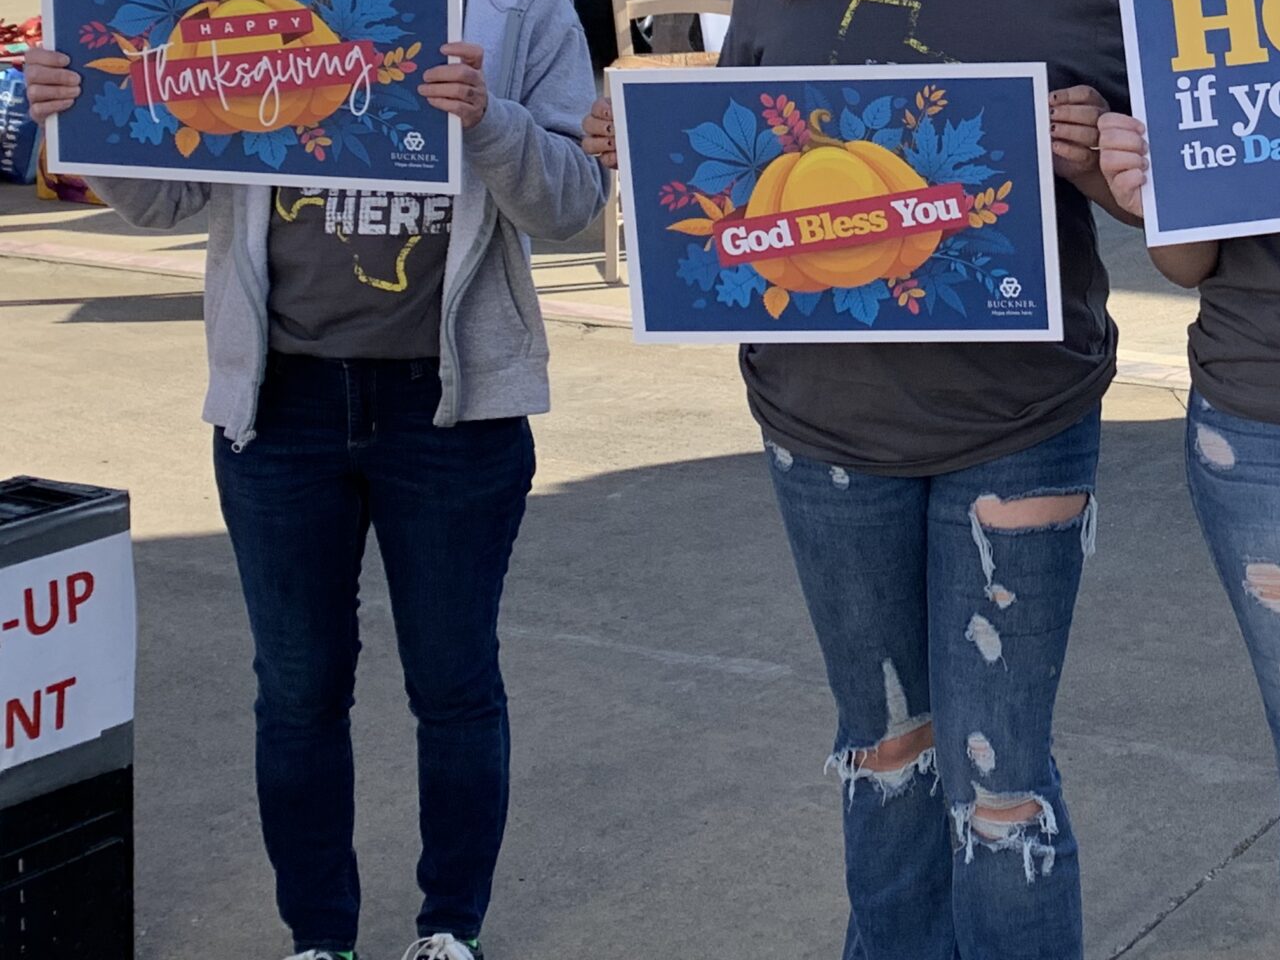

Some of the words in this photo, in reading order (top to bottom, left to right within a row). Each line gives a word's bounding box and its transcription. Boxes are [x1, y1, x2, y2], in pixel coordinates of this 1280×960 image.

[200, 17, 301, 35] HAPPY
[123, 40, 373, 127] Thanksgiving
[1175, 74, 1219, 130] if
[1180, 140, 1236, 171] the
[721, 218, 795, 256] God
[795, 209, 889, 244] Bless
[890, 197, 963, 228] You
